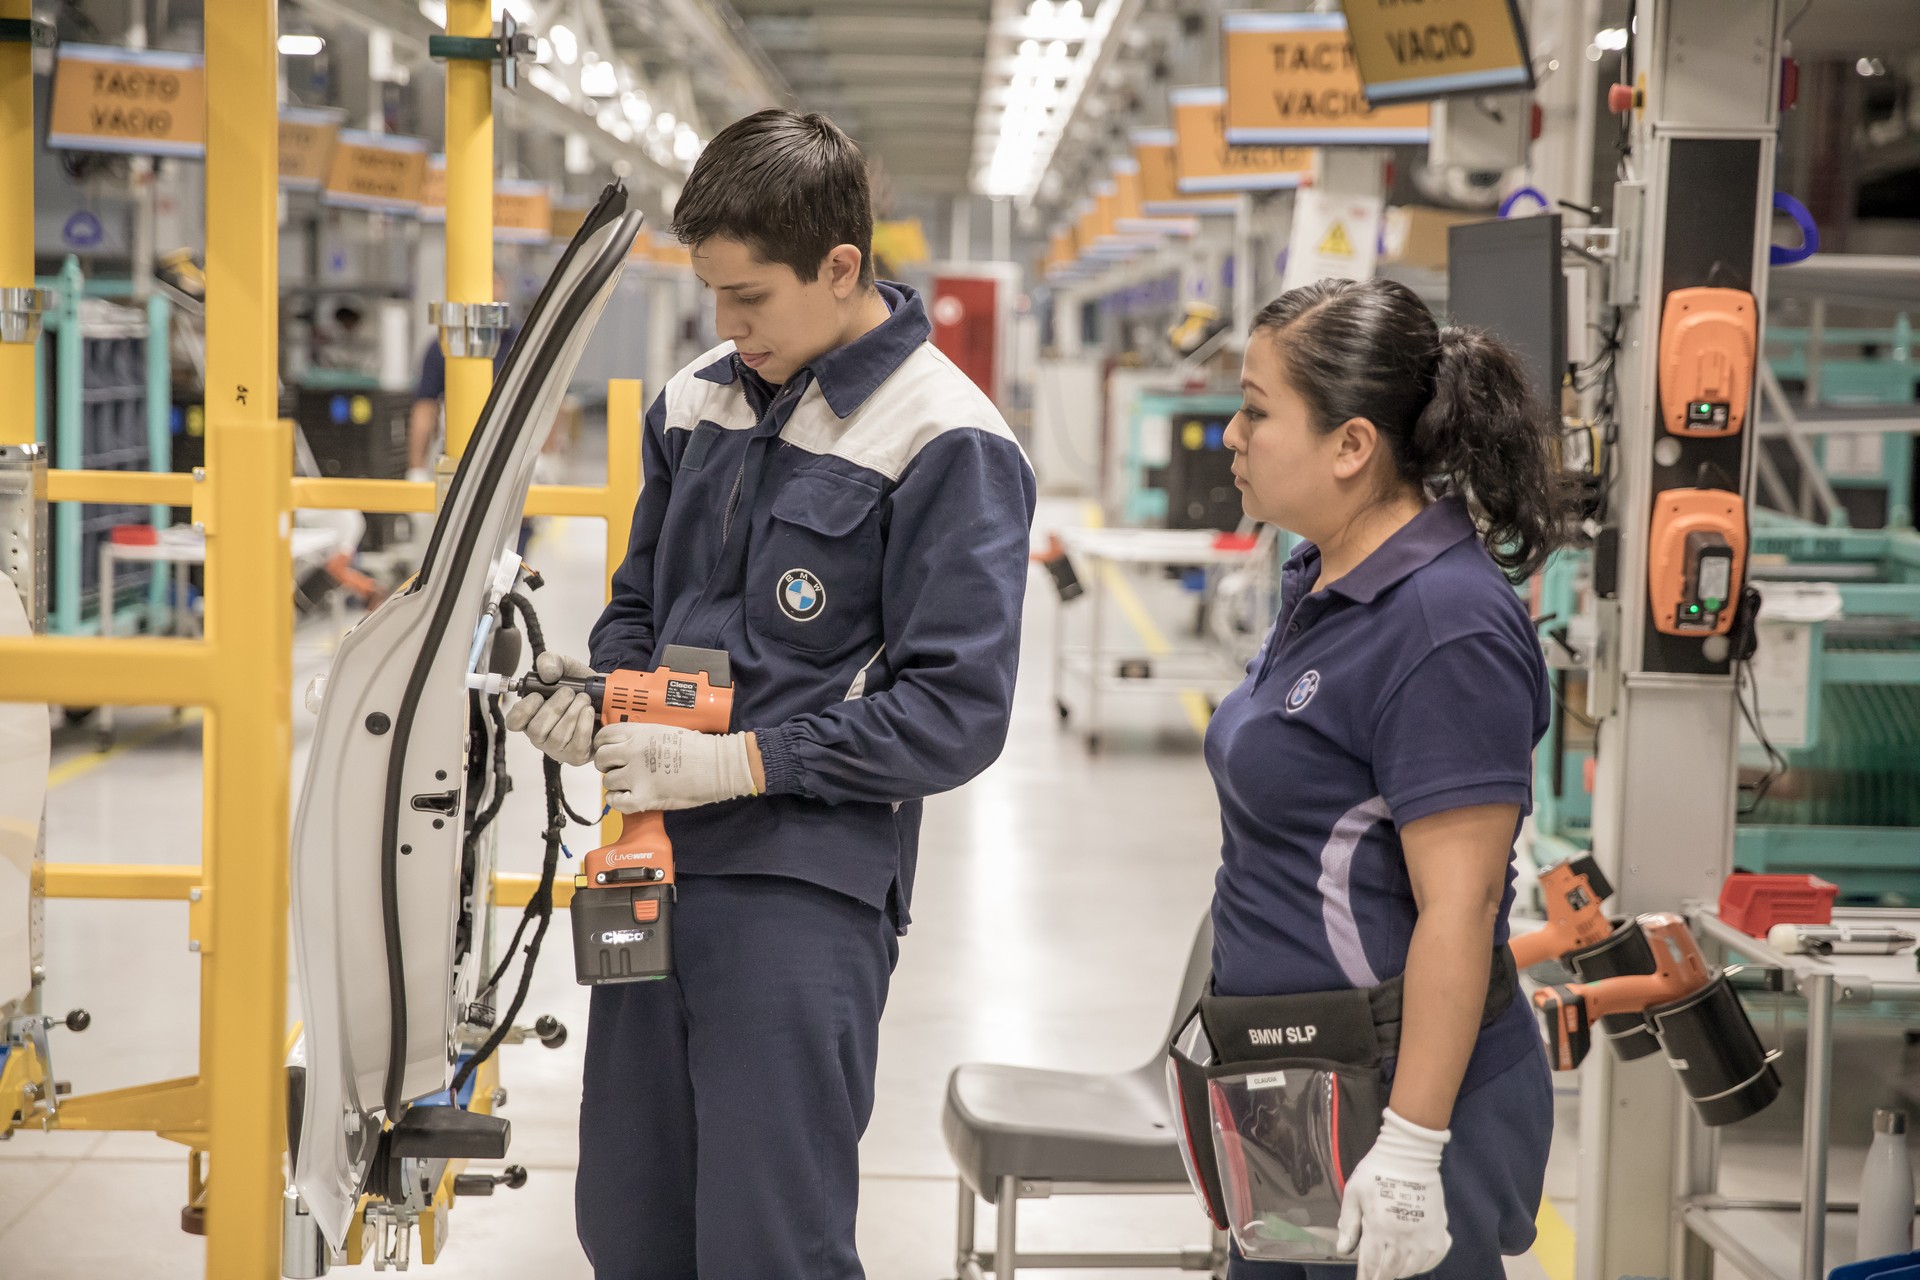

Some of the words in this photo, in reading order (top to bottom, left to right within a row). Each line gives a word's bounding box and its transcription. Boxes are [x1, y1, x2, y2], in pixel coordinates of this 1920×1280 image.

[1271, 42, 1354, 73] TACT
[1386, 22, 1474, 65] VACIO
[89, 68, 180, 103] TACTO
[89, 105, 173, 138] VACIO
[785, 572, 821, 592] BMW
[1248, 1028, 1283, 1045] BMW
[1285, 1025, 1317, 1042] SLP
[1253, 1077, 1277, 1085] CLAUDIA
